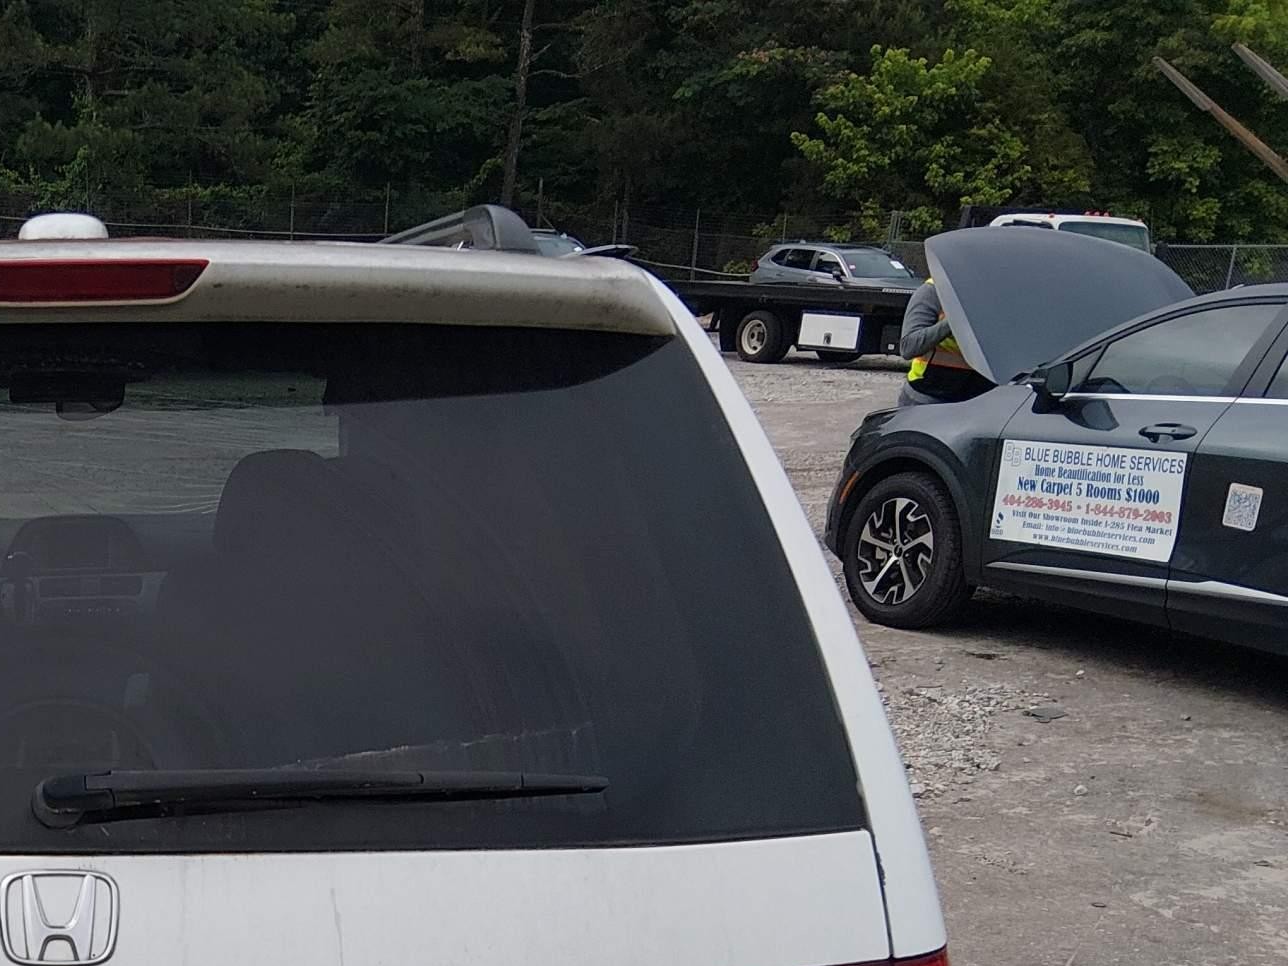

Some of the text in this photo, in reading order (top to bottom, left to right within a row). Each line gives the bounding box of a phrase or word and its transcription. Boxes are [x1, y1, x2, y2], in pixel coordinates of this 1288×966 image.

[1024, 447, 1185, 474] BLUE BUBBLE HOME SERVICES
[1035, 464, 1144, 486] Home Beautification for Less
[1017, 476, 1160, 504] New Carpet 5 Rooms $1000
[1012, 509, 1173, 536] Visit Our Showroom Inside I-285 Flea Market
[1022, 521, 1043, 530] Email:
